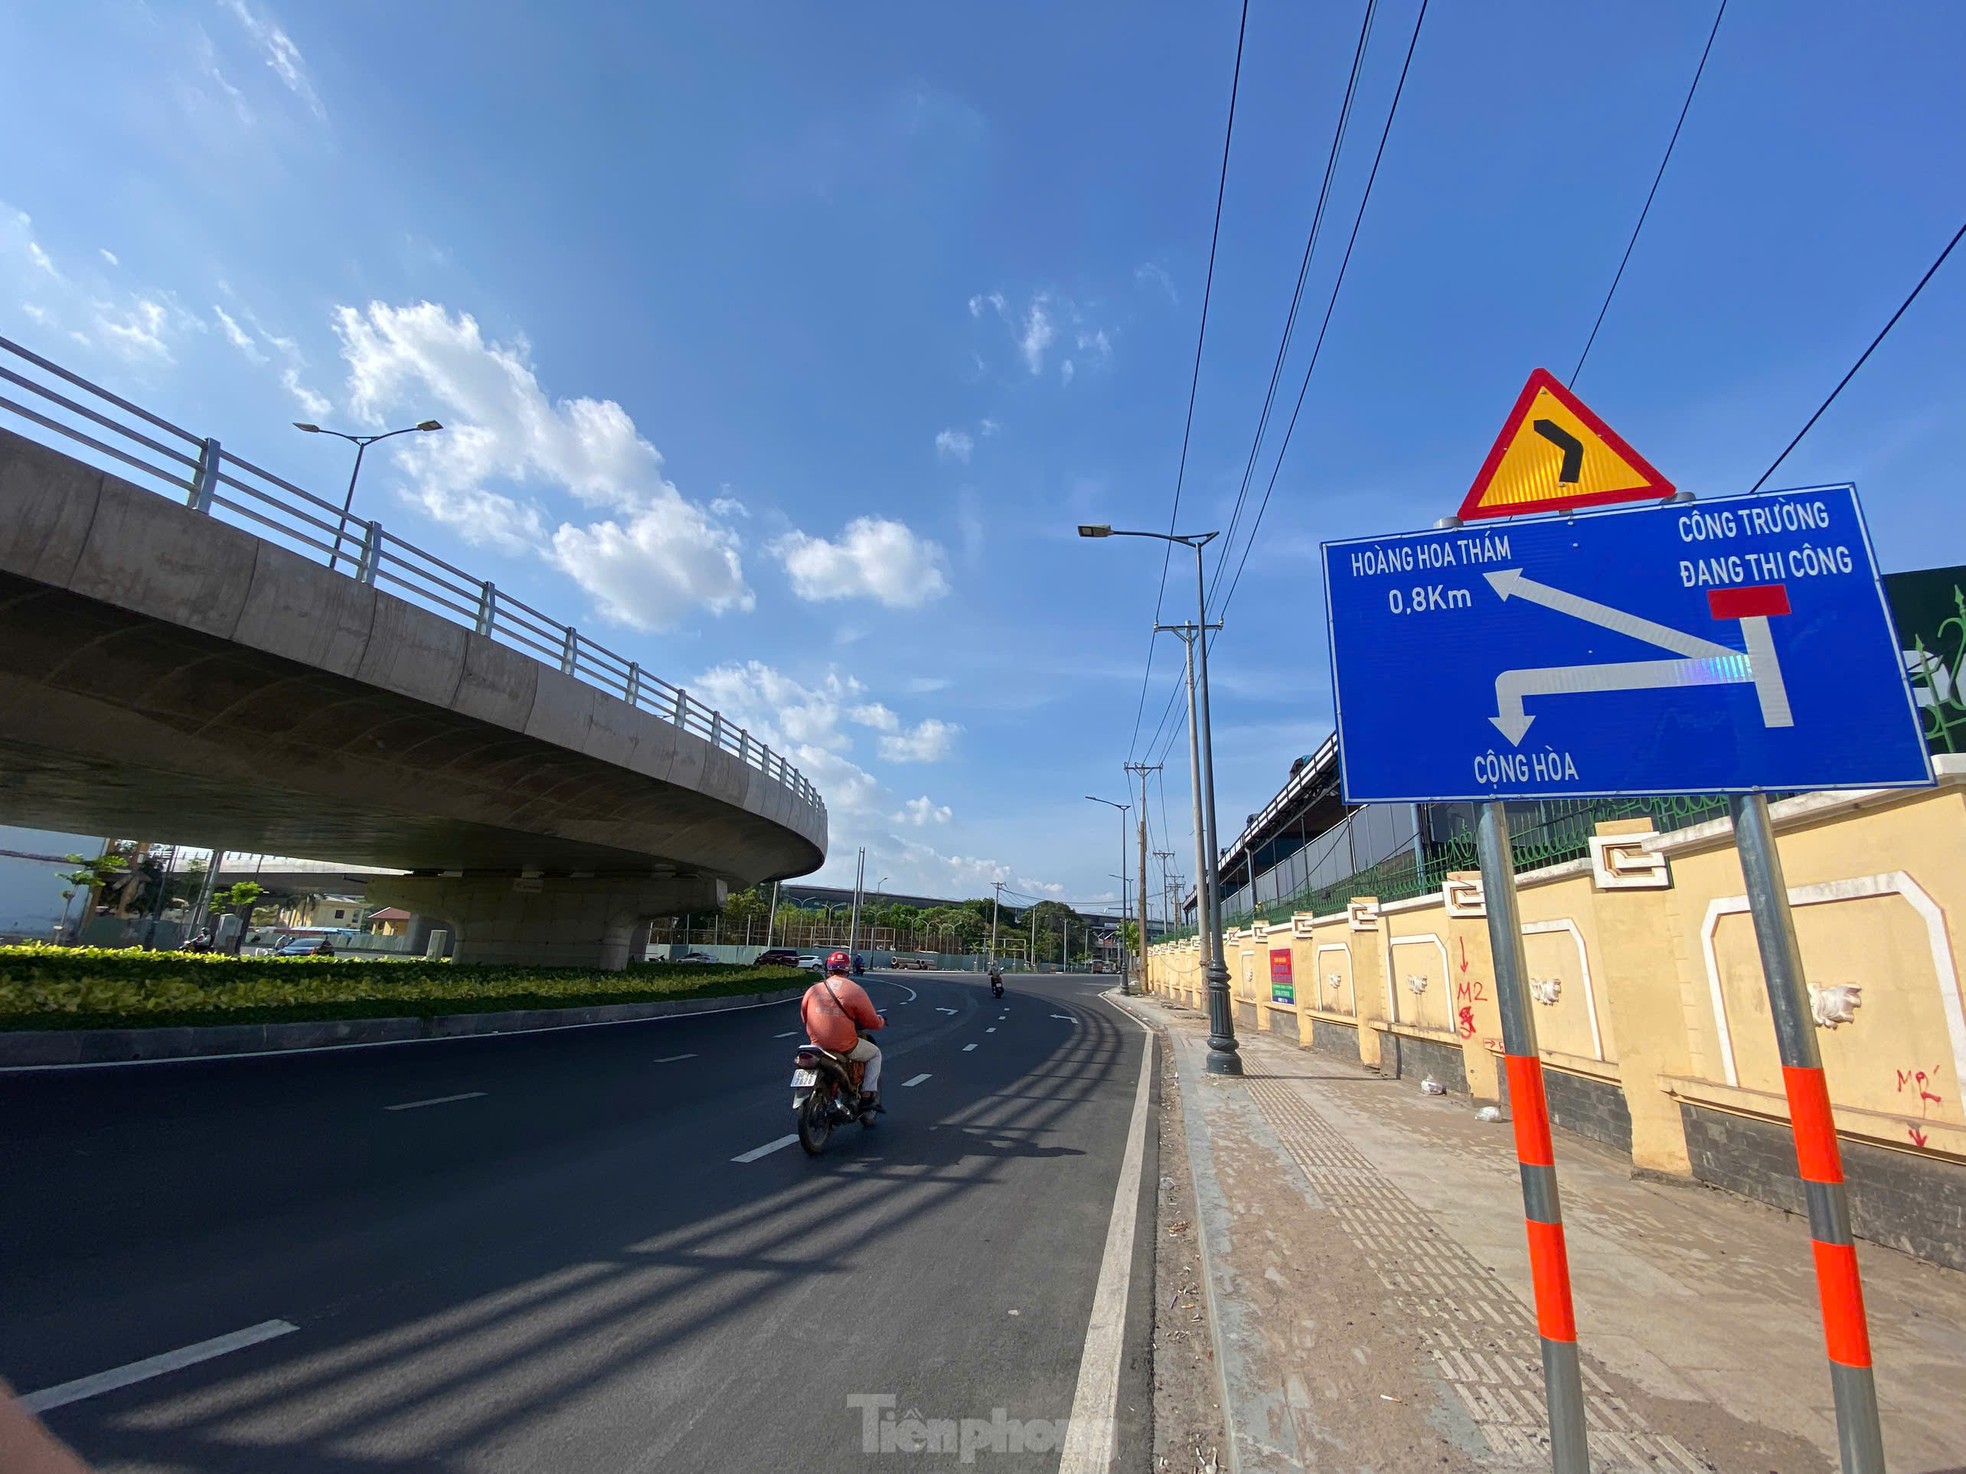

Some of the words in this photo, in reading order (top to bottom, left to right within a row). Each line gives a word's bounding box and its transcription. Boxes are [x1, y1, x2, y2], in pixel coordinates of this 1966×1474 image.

[1678, 509, 1737, 543] CÔNG
[1738, 497, 1829, 536] TRƯỜNG
[1351, 544, 1414, 577] HOÀNG
[1417, 542, 1456, 570] HOA
[1457, 530, 1512, 565] THÁM
[1679, 555, 1744, 588] ĐANG
[1745, 551, 1786, 581] THI
[1788, 542, 1853, 578] CÔNG
[1388, 584, 1472, 615] 0,8Km
[1474, 748, 1529, 789] CỘNG
[1532, 745, 1579, 782] HÒA
[1457, 981, 1488, 1003] M2
